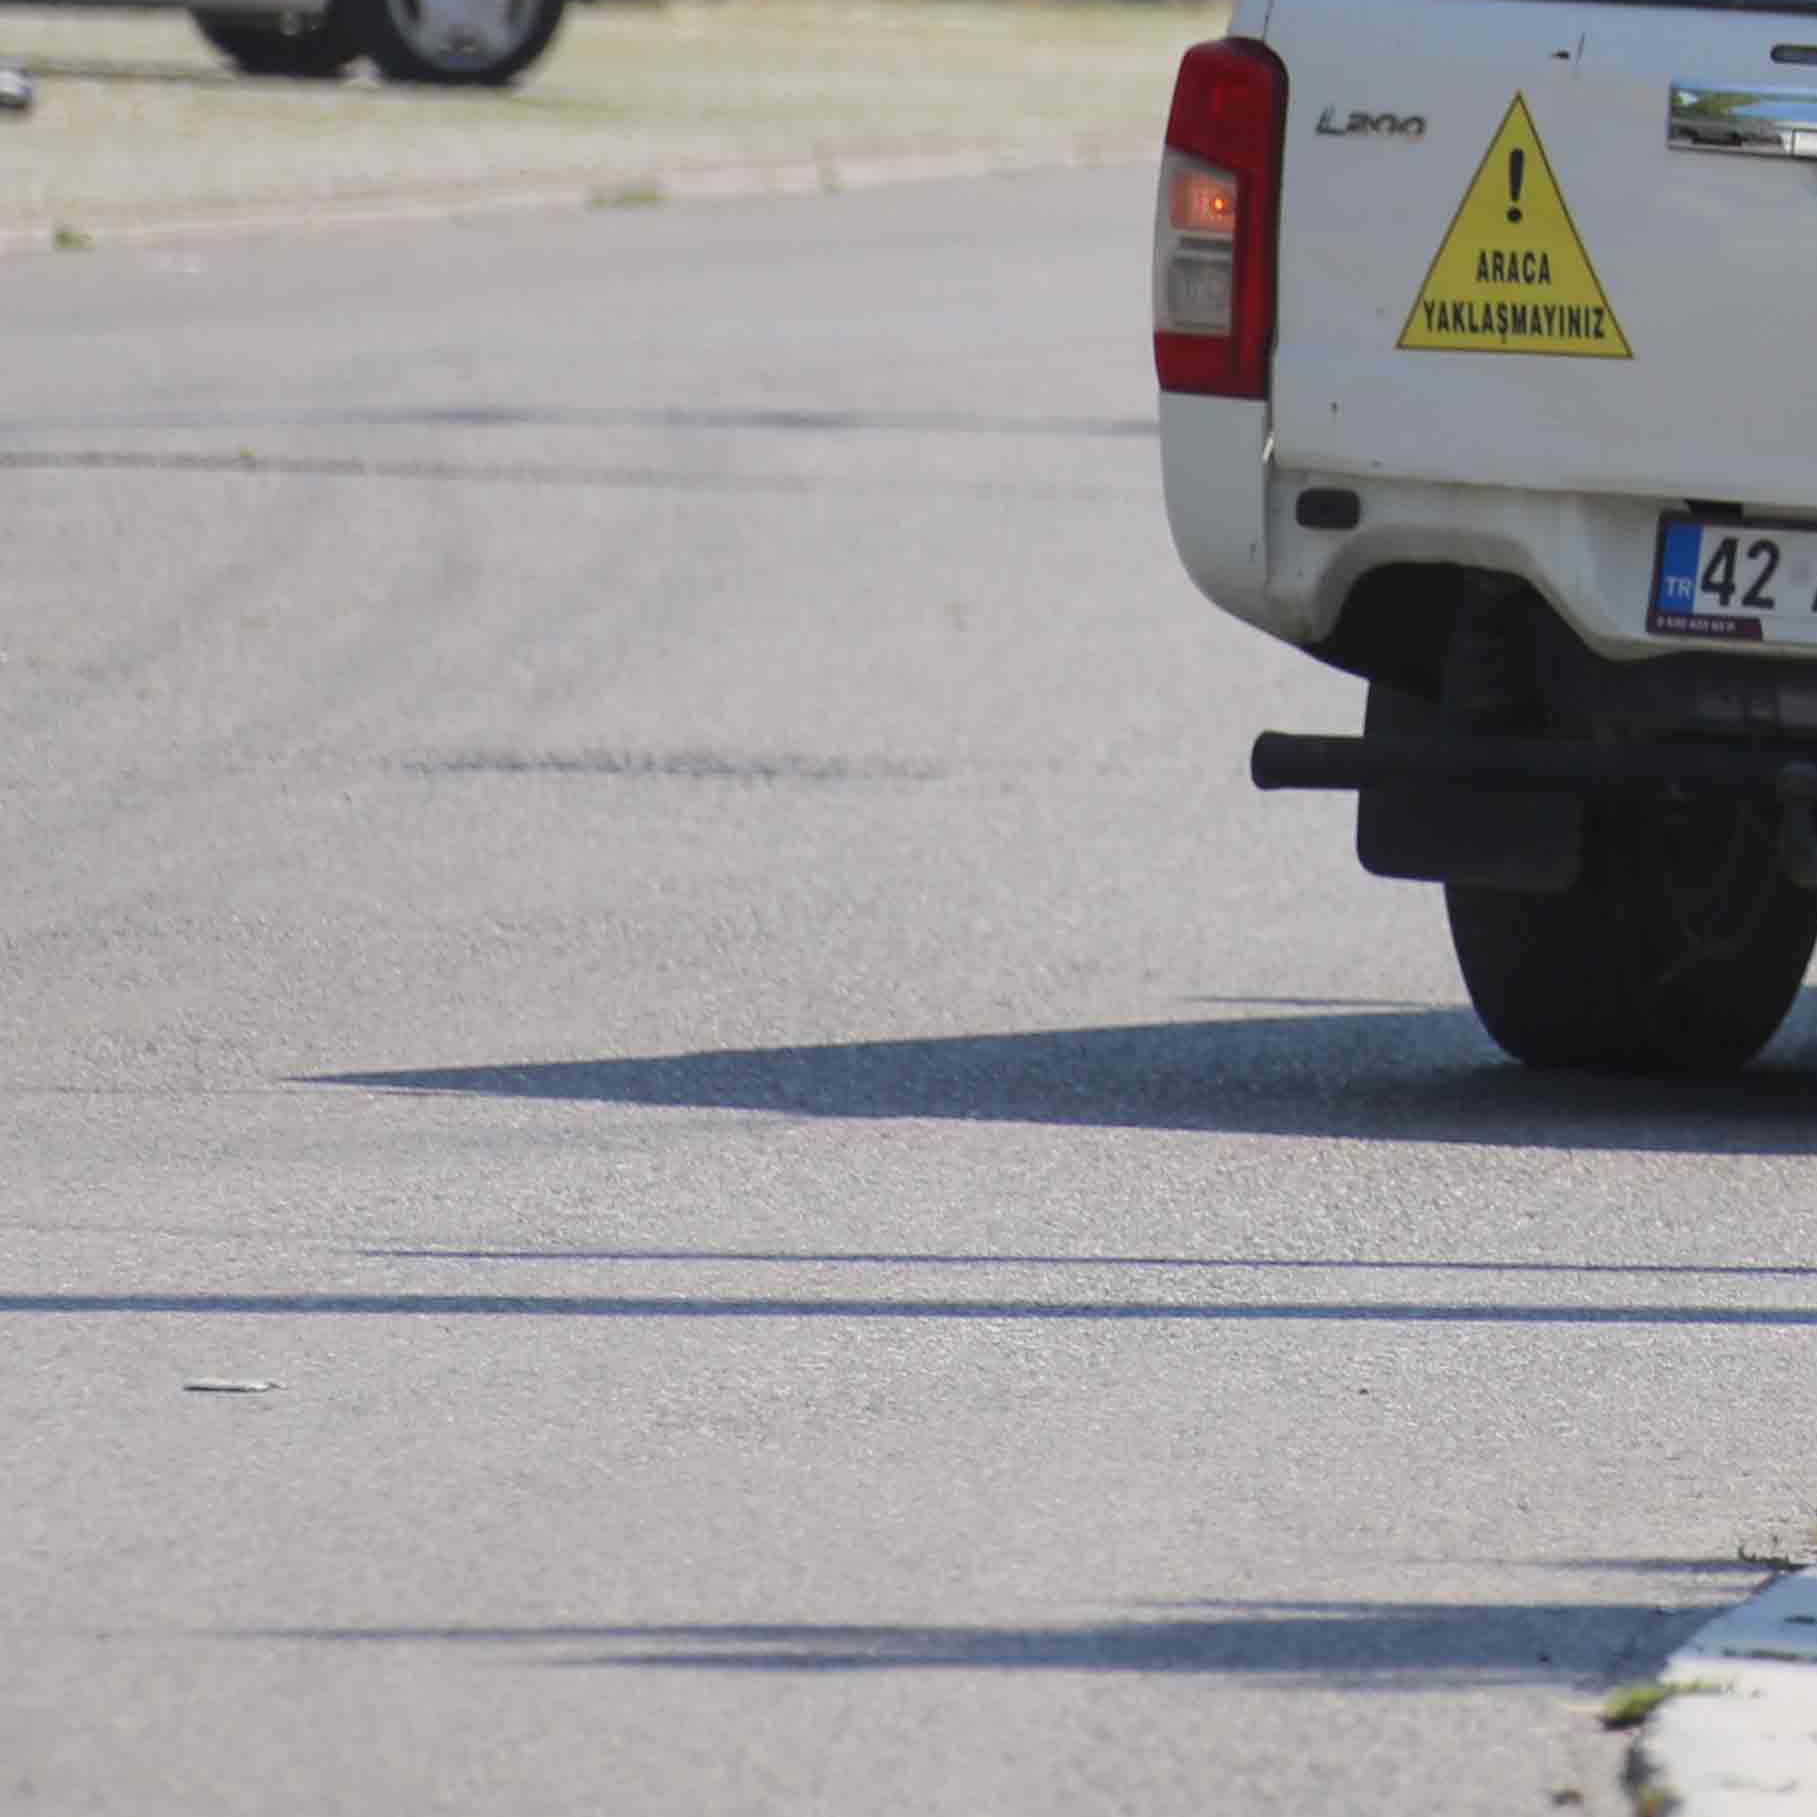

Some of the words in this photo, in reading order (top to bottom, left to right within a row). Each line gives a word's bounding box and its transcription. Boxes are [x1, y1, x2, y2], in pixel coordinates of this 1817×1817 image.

[1476, 251, 1552, 284] ARACA
[1423, 300, 1606, 344] YAKLAŞMAYINIZ
[1664, 576, 1693, 599] TR
[1701, 537, 1779, 609] 42
